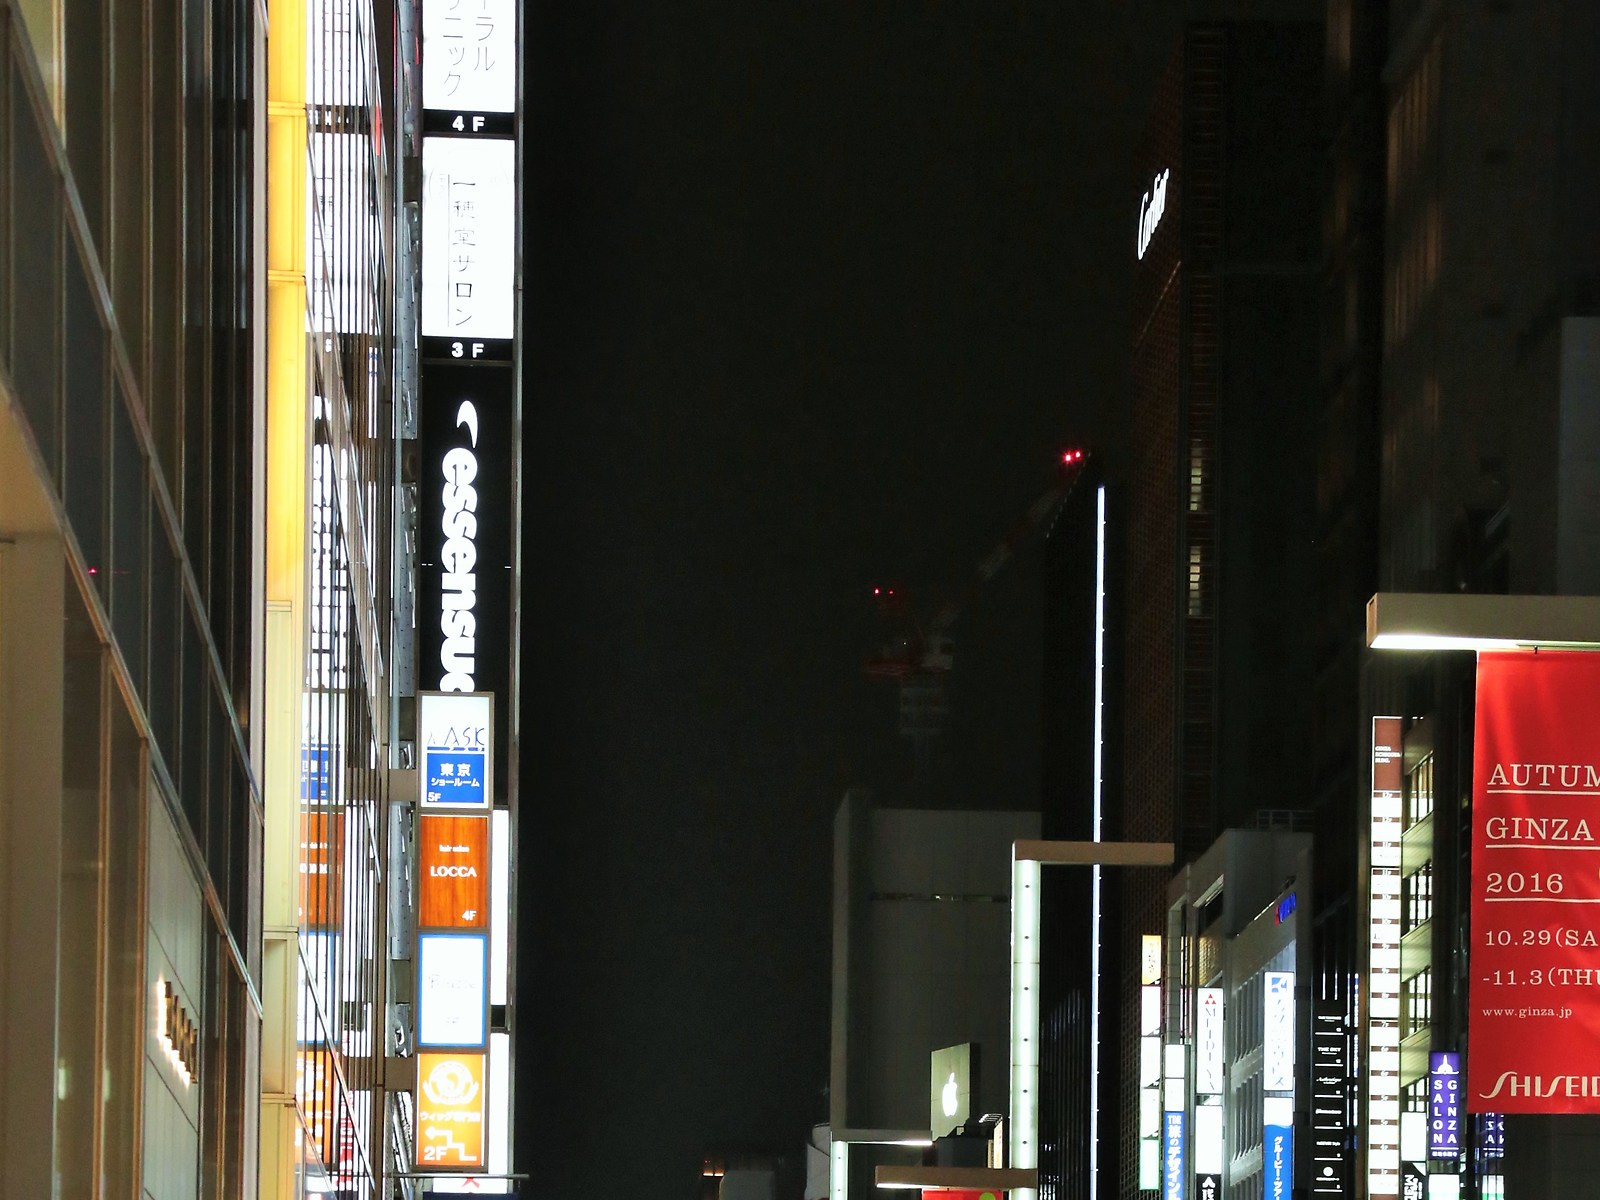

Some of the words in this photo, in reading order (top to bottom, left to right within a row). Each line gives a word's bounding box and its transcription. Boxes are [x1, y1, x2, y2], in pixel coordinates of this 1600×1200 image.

[440, 763, 471, 777] 東京
[427, 792, 441, 802] 5F
[1486, 817, 1594, 841] GINZA
[430, 866, 477, 877] LOCCA
[1486, 872, 1564, 894] 2016
[462, 910, 477, 920] 4F
[1482, 1006, 1573, 1019] www.ginza.jp
[1433, 1080, 1443, 1144] SALON
[1447, 1080, 1457, 1144] GINZA
[424, 1146, 447, 1161] 2F
